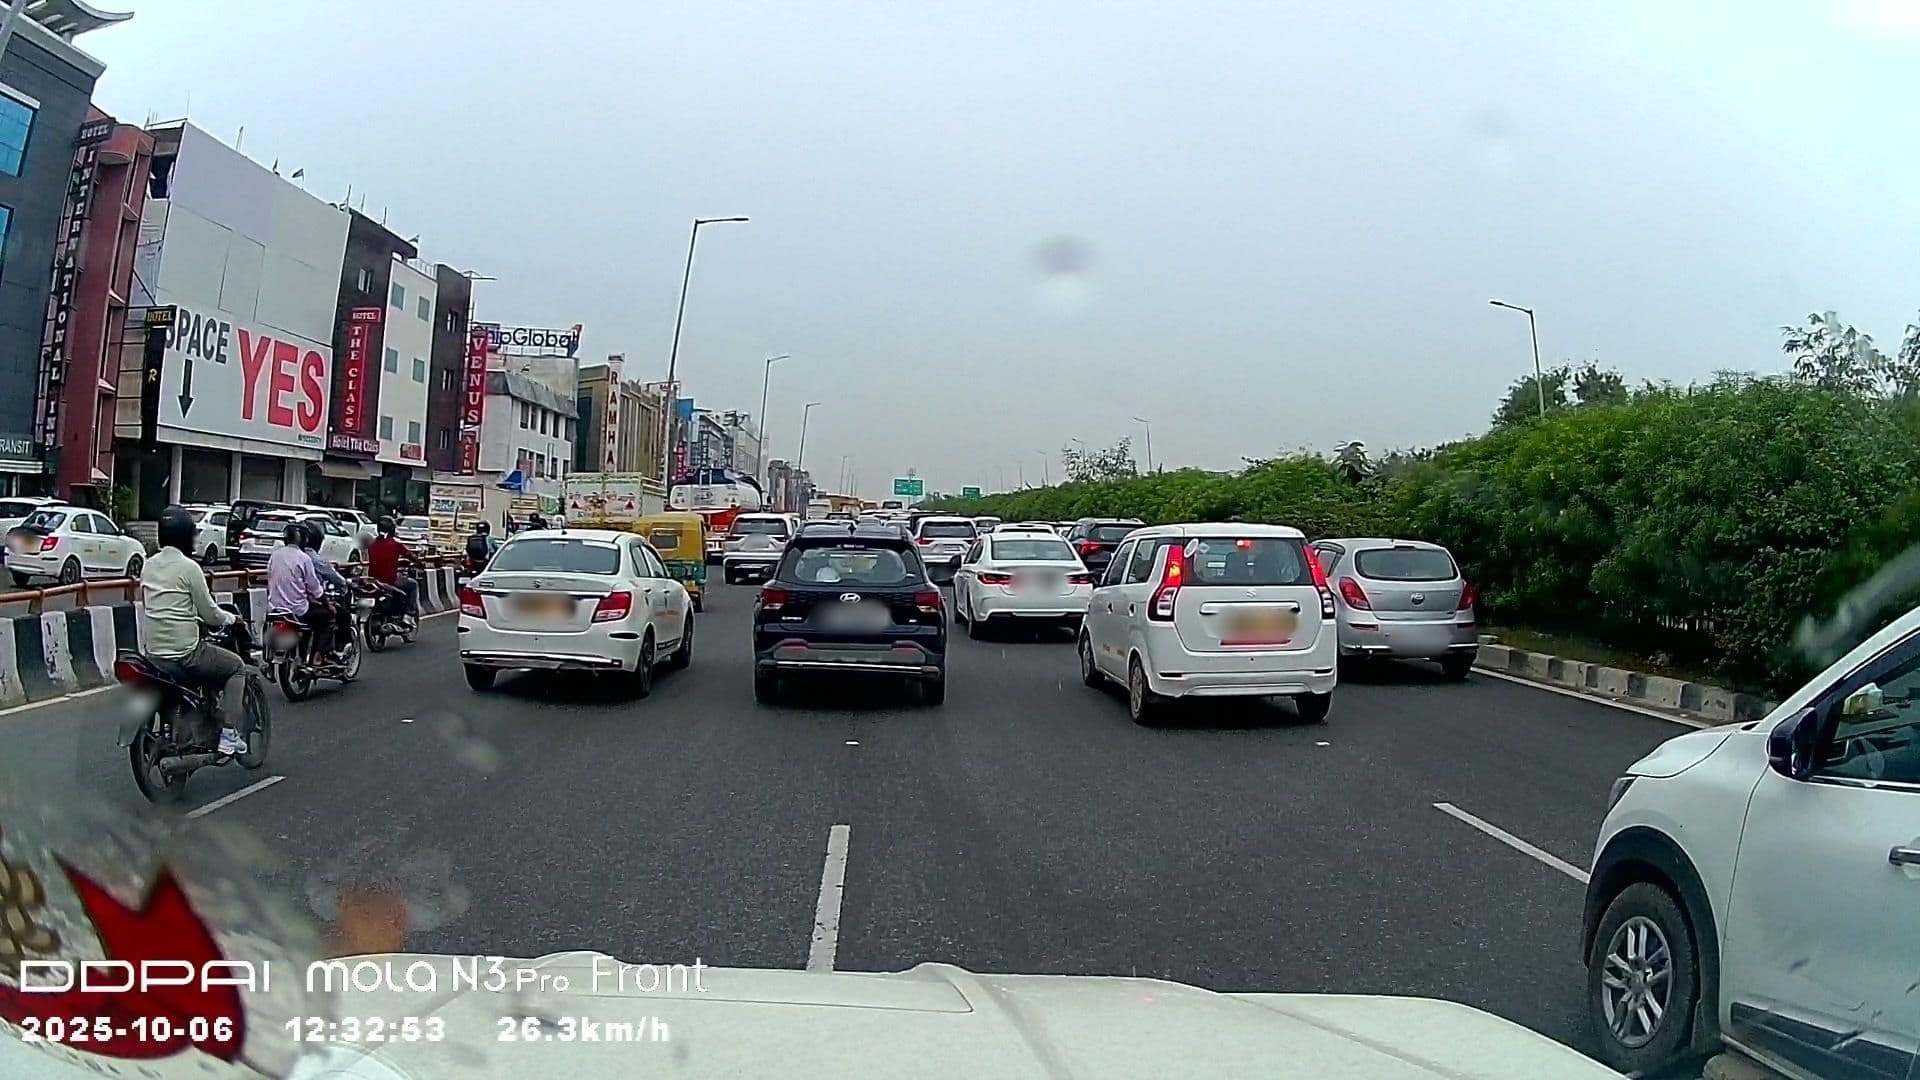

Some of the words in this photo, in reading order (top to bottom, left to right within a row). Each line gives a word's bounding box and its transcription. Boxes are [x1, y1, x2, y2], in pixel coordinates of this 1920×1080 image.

[81, 124, 109, 140] HOTEL
[51, 150, 94, 380] INTERNATIONAL
[147, 310, 173, 322] HOTEL
[352, 311, 377, 321] HOTEL
[350, 326, 361, 361] THE
[237, 328, 325, 433] YES
[345, 368, 358, 428] CLASS
[468, 338, 485, 423] VENUS
[45, 402, 57, 446] INN
